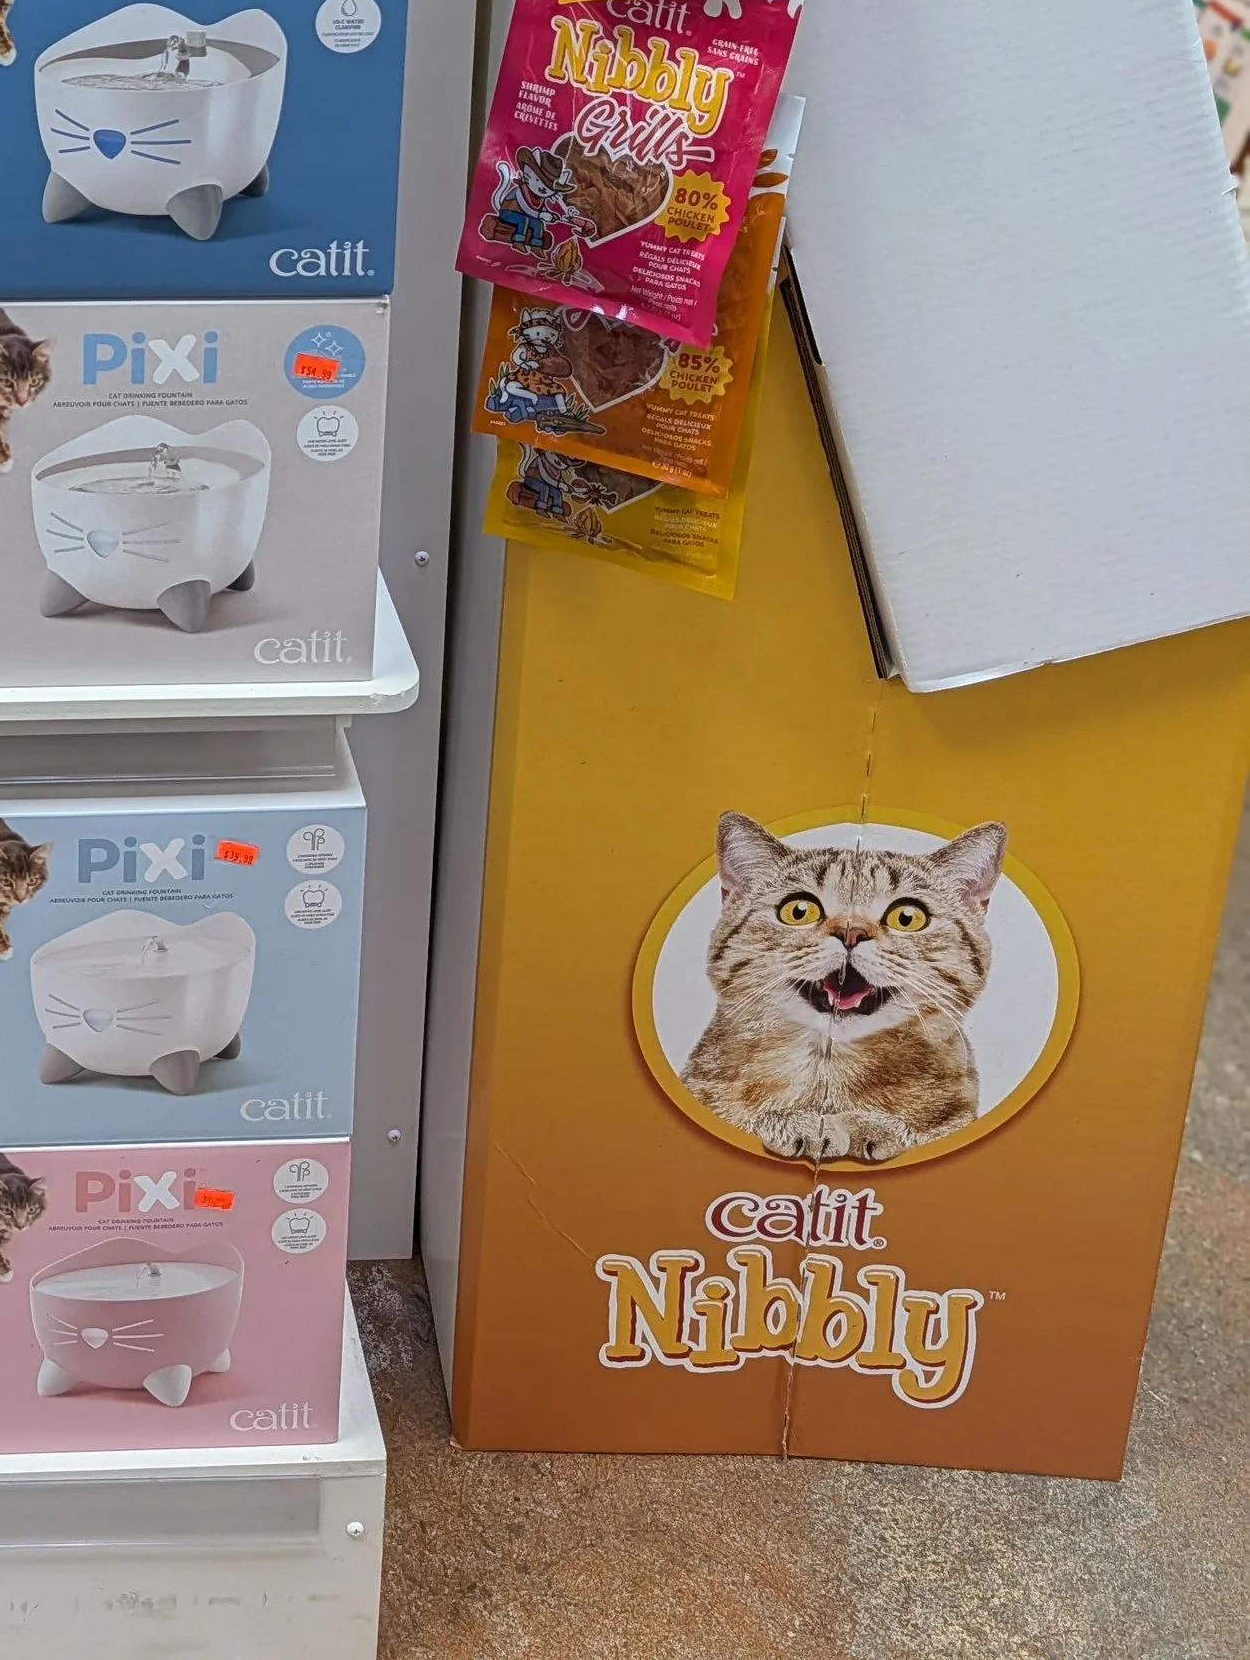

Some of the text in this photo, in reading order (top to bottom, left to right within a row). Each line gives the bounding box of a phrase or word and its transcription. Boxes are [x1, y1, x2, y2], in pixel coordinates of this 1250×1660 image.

[707, 46, 759, 65] SANS GRAINS
[712, 38, 759, 56] GRAIN-FREE
[546, 16, 732, 135] Nibbly
[518, 90, 552, 107] FLAVOR
[521, 81, 555, 96] SHRIMP
[516, 102, 556, 119] ARÔME DE
[514, 112, 559, 131] CREVETTES
[577, 98, 713, 168] Grills
[675, 188, 719, 211] 80%
[667, 207, 715, 224] CHICKEN
[667, 217, 710, 232] POULET
[269, 241, 370, 277] catit
[641, 241, 667, 252] YUMMY
[683, 249, 705, 260] TREATS
[633, 267, 700, 287] DELICIOSOS SNACKS
[649, 262, 690, 274] POUR CHATS
[645, 278, 687, 290] PARA GATOS
[83, 331, 218, 385] Pixi
[677, 352, 721, 374] 85%
[669, 371, 718, 385] CHICKEN
[671, 379, 714, 393] POULET
[254, 630, 347, 664] catit
[78, 834, 206, 883] Pixi
[240, 1091, 329, 1122] catit
[76, 1168, 196, 1213] Pixi
[709, 1187, 883, 1246] catit
[599, 1248, 982, 1405] Nibbly
[230, 1402, 312, 1432] catit
